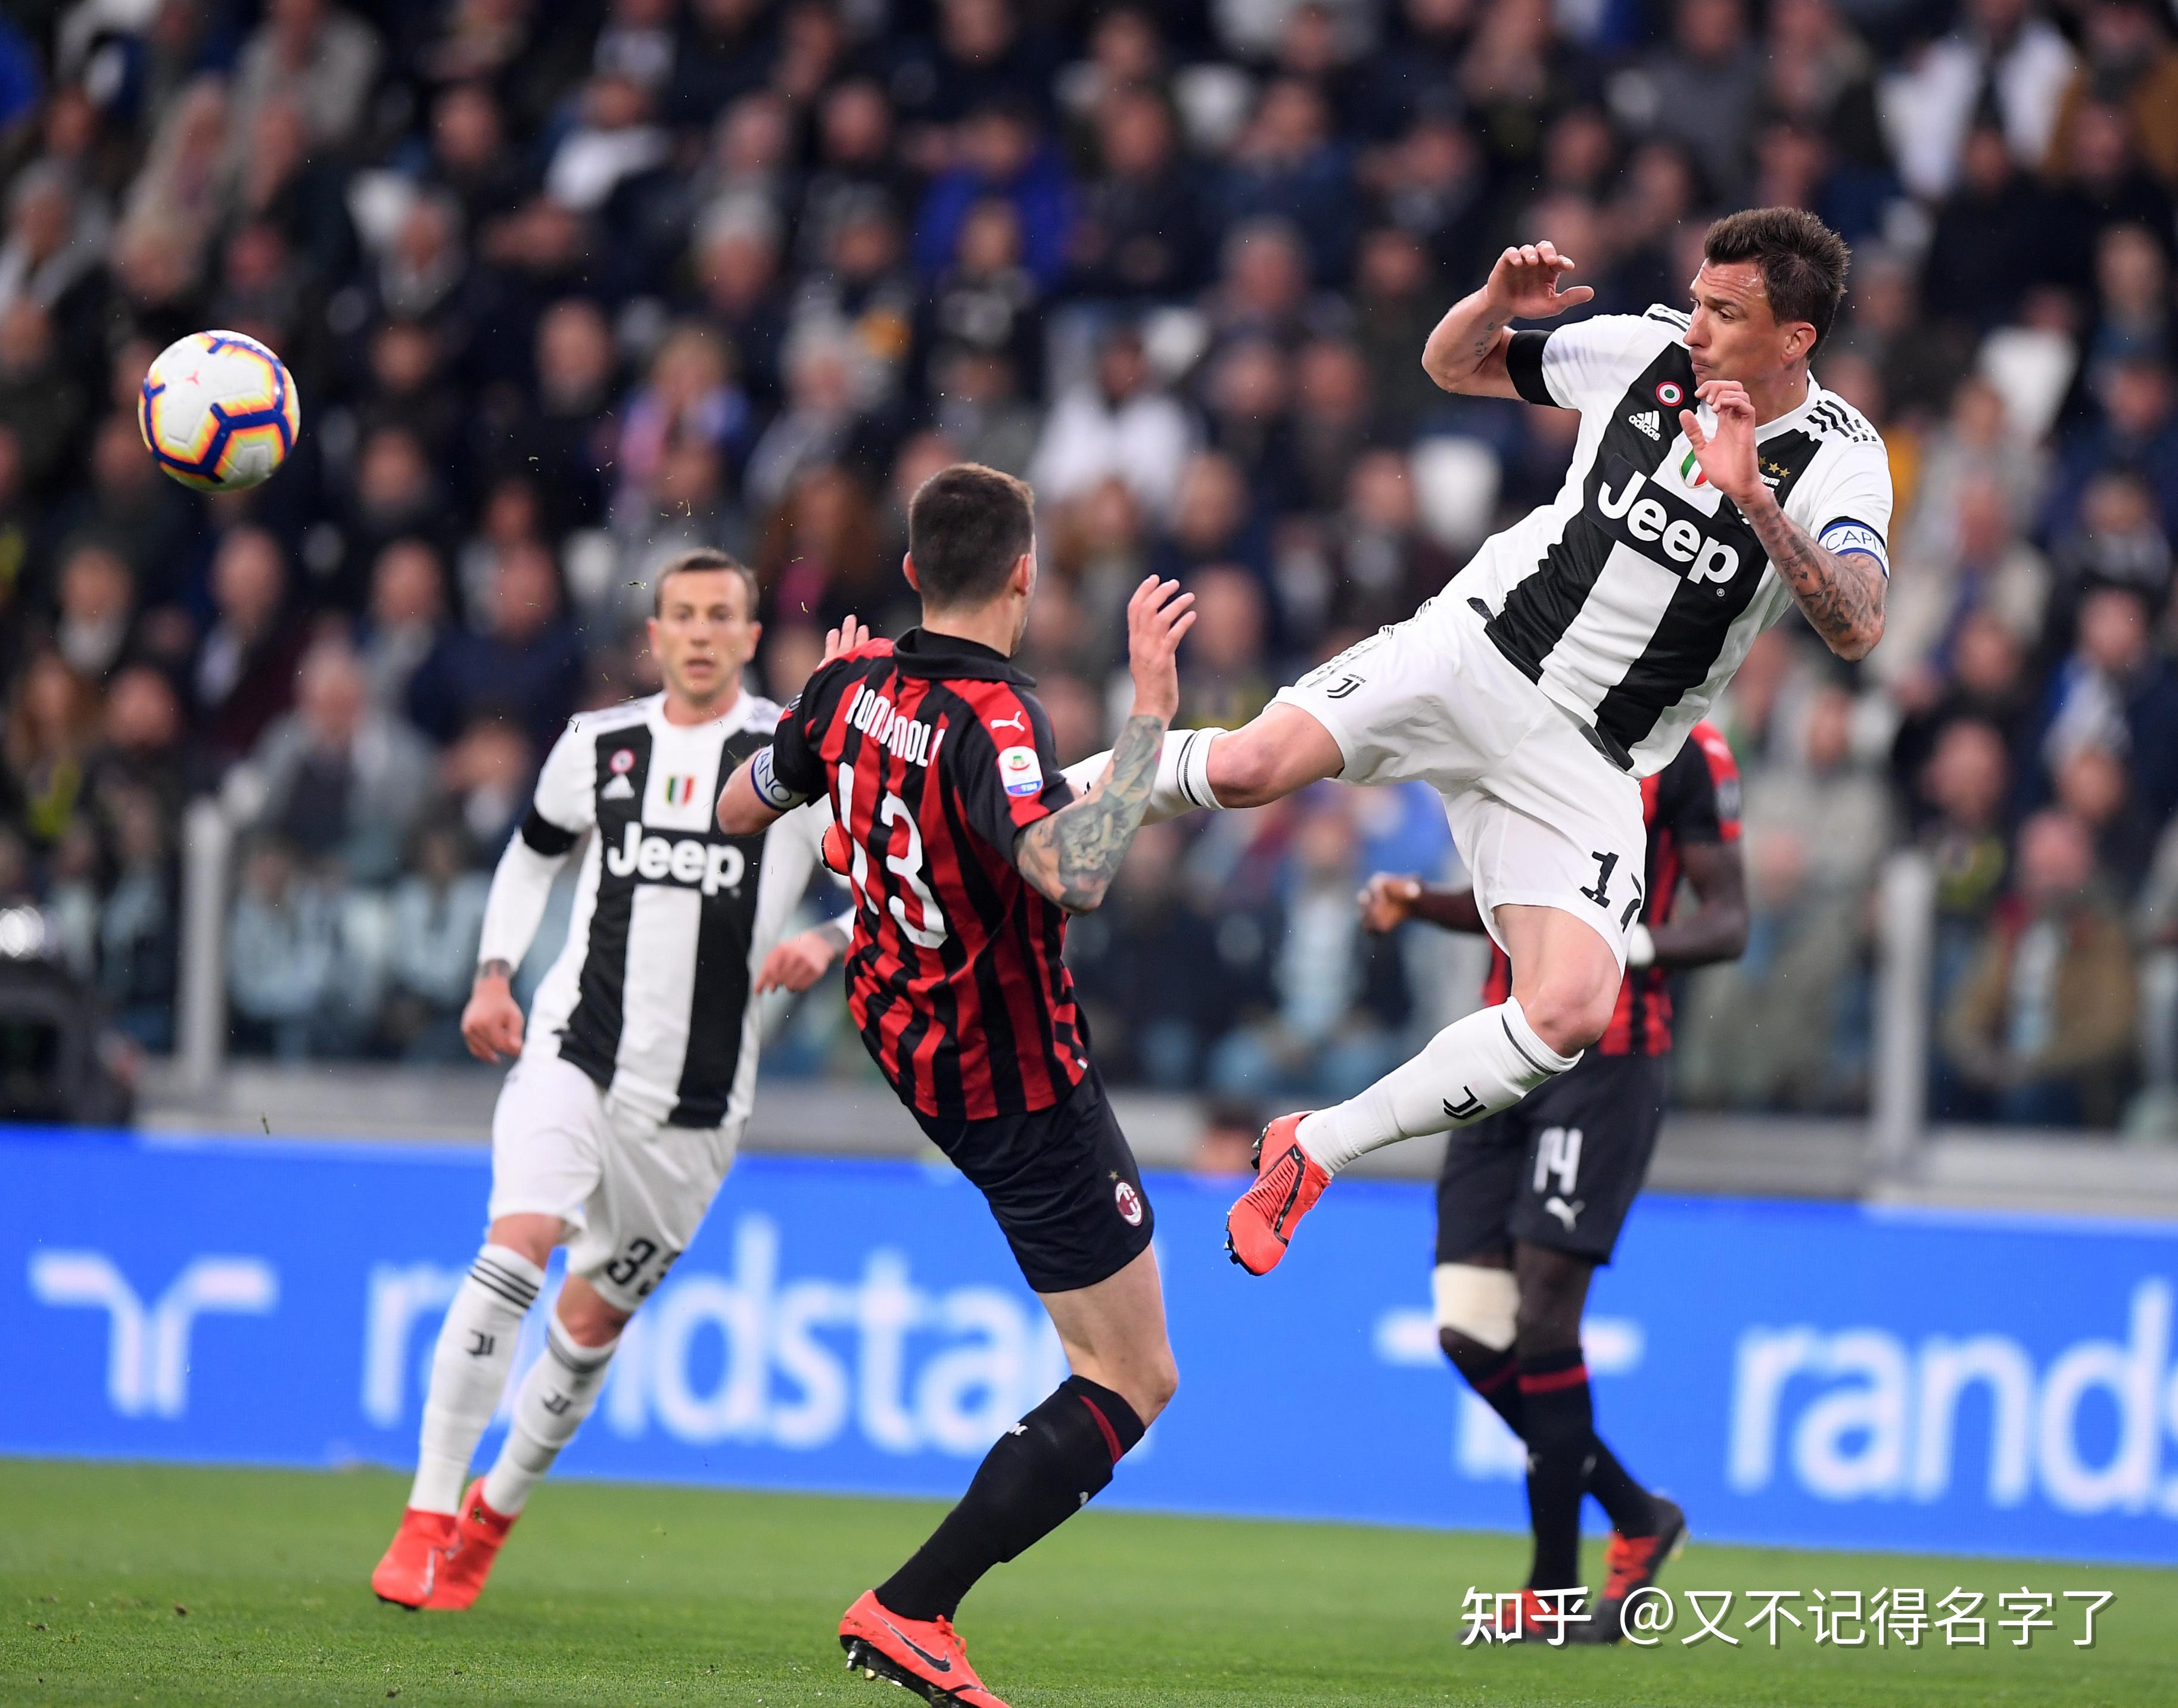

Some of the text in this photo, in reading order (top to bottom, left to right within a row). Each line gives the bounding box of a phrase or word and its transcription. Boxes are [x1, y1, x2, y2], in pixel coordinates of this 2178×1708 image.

[1628, 415, 1661, 441] adidas
[1598, 470, 1739, 584] Jeep
[844, 683, 945, 767] ROMANOLI
[606, 820, 745, 896] Jeep
[838, 761, 948, 949] 13
[1532, 1127, 1583, 1194] 14
[1728, 1278, 2178, 1516] rand
